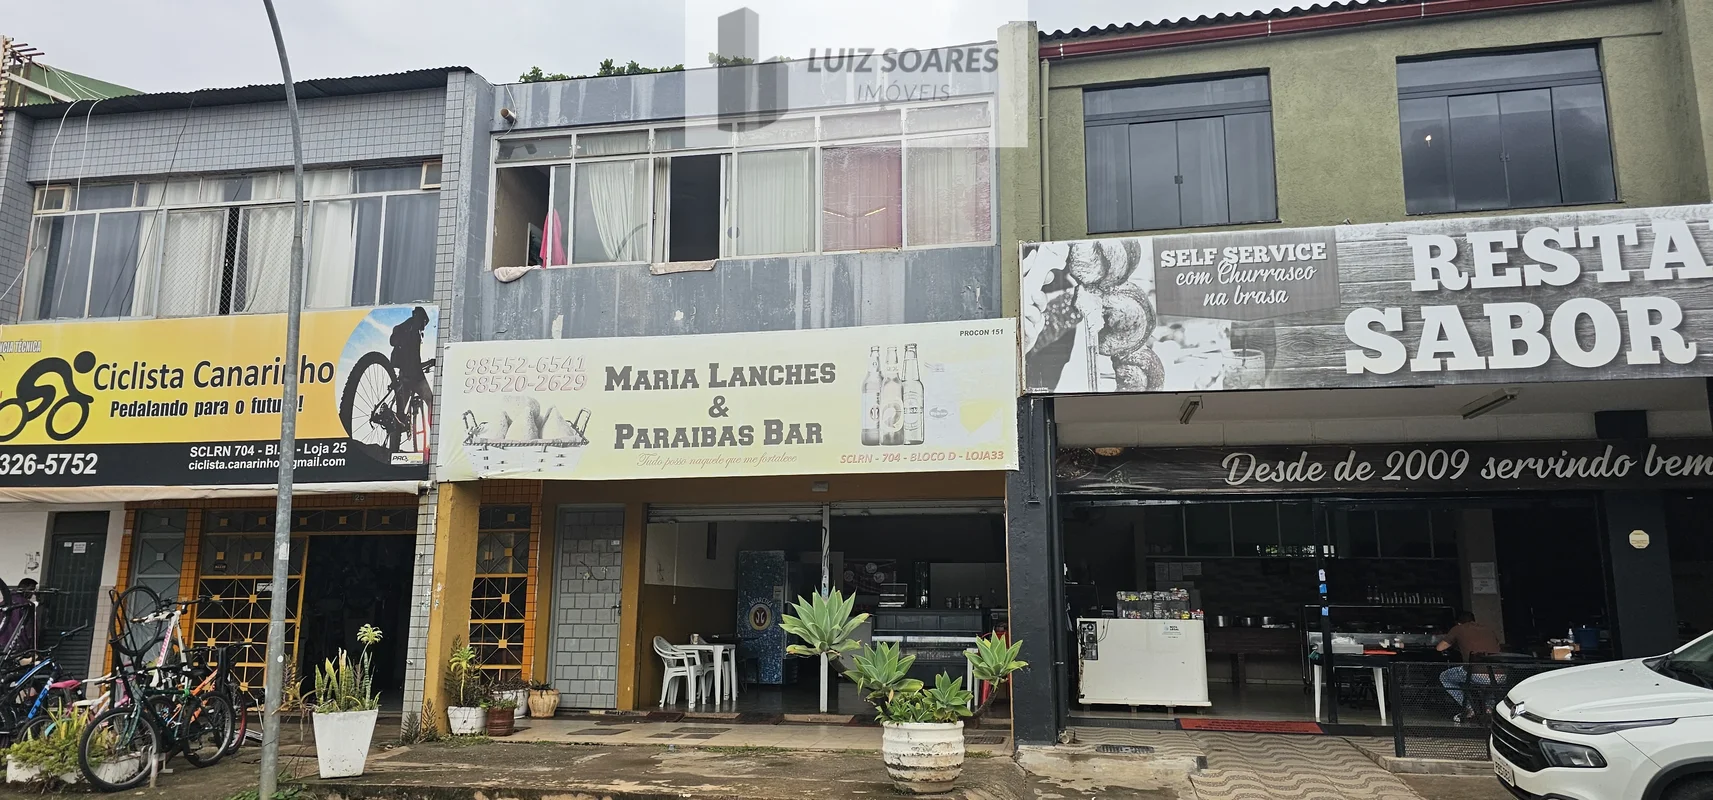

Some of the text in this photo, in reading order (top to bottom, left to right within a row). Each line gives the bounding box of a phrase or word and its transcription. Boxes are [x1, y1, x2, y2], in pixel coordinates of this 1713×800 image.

[1160, 242, 1327, 268] SELF SERVICE
[1406, 220, 1713, 292] RESTA
[1175, 260, 1316, 286] com Churrasco
[1203, 285, 1289, 307] na brasa
[959, 329, 989, 337] PROCON
[1344, 296, 1697, 375] SABOR
[15, 338, 42, 353] TÉCNICA
[94, 354, 335, 391] Ciclista Canariho
[464, 355, 587, 375] 98552-6541
[604, 362, 836, 391] MARIA LANCHES
[464, 373, 588, 394] 98520-2629
[110, 394, 304, 418] Pedalando para o futu!
[708, 395, 729, 418] &
[614, 418, 823, 450] PARAIBAS BAR
[189, 445, 231, 458] SCLRN
[234, 444, 255, 457] 704
[304, 442, 329, 457] Loja
[332, 442, 348, 454] 25
[636, 453, 663, 466] Tudo
[661, 457, 687, 470] posso
[689, 454, 724, 469] naquele
[725, 456, 741, 469] que
[754, 452, 797, 467] fortalece
[840, 453, 873, 464] SCLRN
[882, 453, 901, 463] 704
[910, 452, 946, 463] BLOCO
[948, 451, 956, 461] D
[0, 453, 98, 476] 326-5752
[188, 456, 346, 471] ciclista.canarinhogmail.com
[1221, 444, 1713, 486] Desde de 2009 servindo bem
